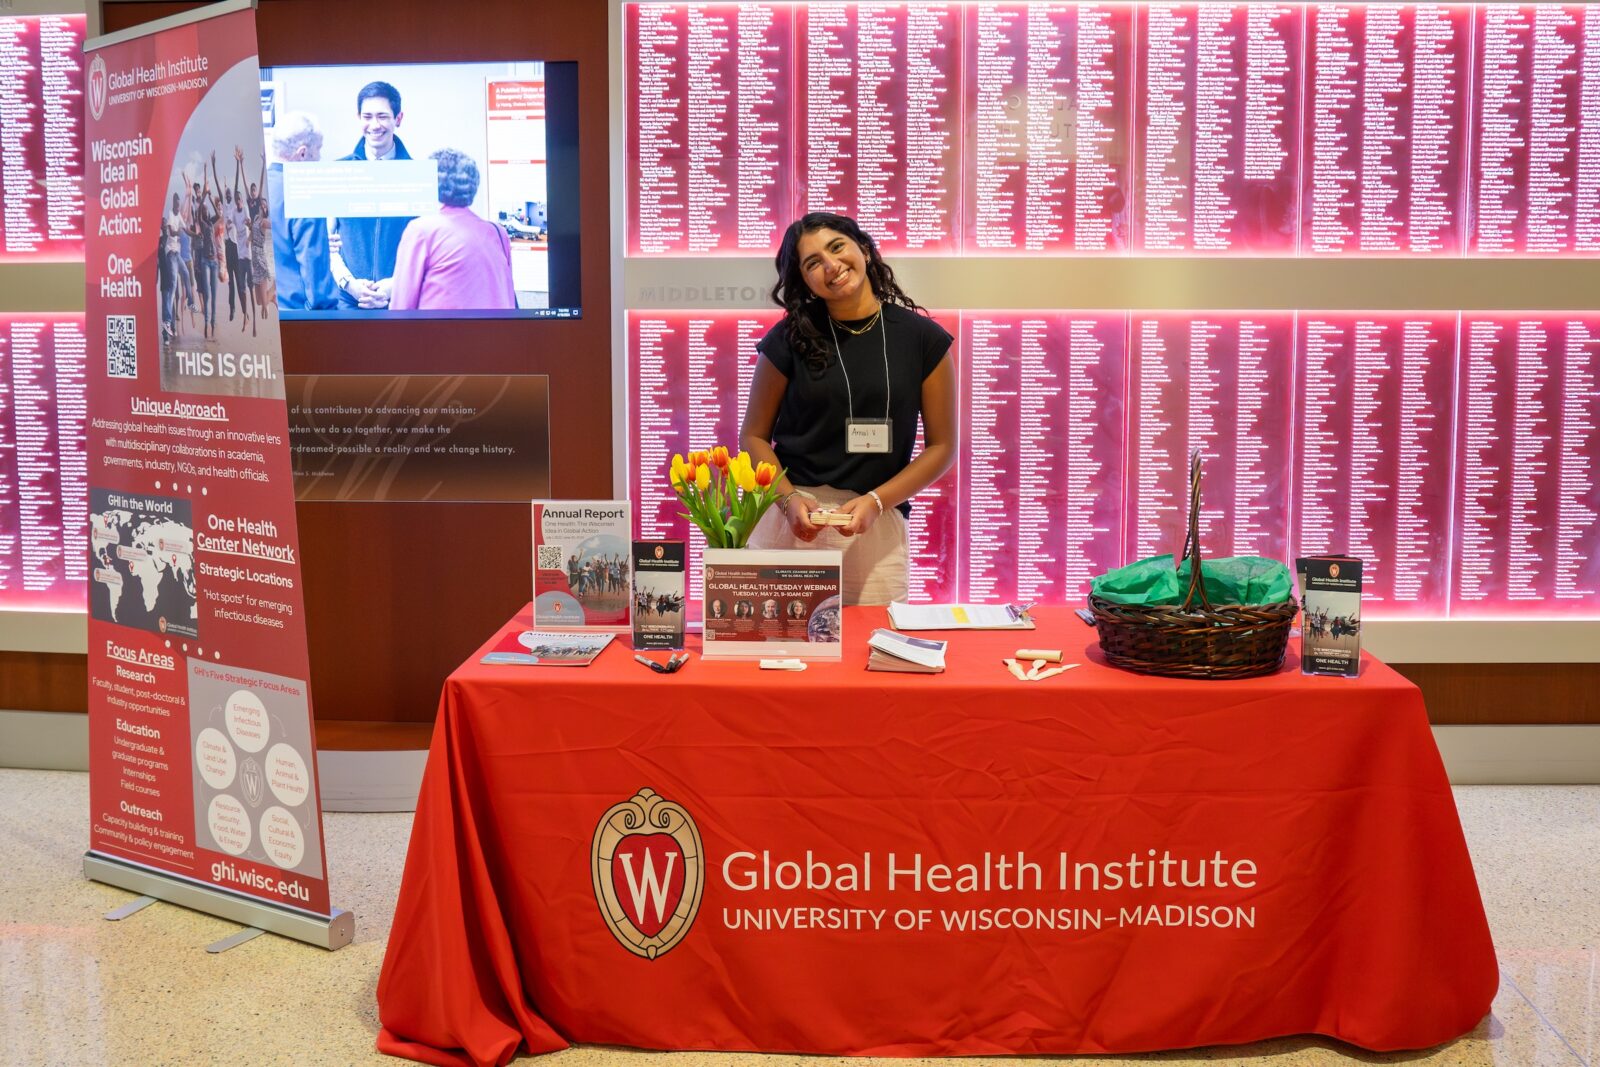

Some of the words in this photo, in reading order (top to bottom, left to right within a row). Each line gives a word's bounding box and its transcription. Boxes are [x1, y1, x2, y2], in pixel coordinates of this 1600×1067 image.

[109, 69, 135, 90] Global
[136, 63, 166, 84] Health
[168, 55, 208, 76] Institute
[109, 91, 136, 106] UNIVERSITY
[137, 89, 145, 100] OF
[92, 133, 152, 162] Wisconsin
[101, 163, 125, 184] Idea
[127, 160, 138, 181] in
[100, 185, 139, 210] Global
[98, 213, 142, 236] Action:
[107, 253, 132, 275] One
[101, 275, 142, 298] Health
[176, 352, 214, 377] THIS
[218, 353, 236, 377] IS
[239, 353, 276, 380] GHI.
[131, 397, 171, 418] Unique
[173, 399, 226, 420] Approach
[291, 405, 300, 415] of
[302, 407, 312, 415] us
[315, 405, 361, 415] contributes
[364, 405, 373, 415] to
[376, 405, 420, 417] advancing
[423, 407, 438, 415] our
[441, 405, 476, 416] mission;
[92, 417, 122, 433] Addressing
[123, 421, 142, 433] global
[144, 421, 167, 434] health
[168, 424, 186, 436] issues
[187, 426, 213, 441] through
[215, 430, 225, 439] an
[227, 429, 265, 443] innovative
[266, 433, 281, 445] lens
[288, 425, 311, 434] when
[328, 425, 340, 434] do
[355, 425, 393, 436] together,
[411, 425, 435, 434] make
[437, 425, 451, 434] the
[105, 437, 117, 447] with
[118, 438, 171, 455] multidisciplinary
[172, 443, 217, 458] collaborations
[218, 448, 226, 458] in
[227, 450, 265, 464] academia,
[383, 444, 411, 455] reality
[414, 444, 431, 453] and
[448, 444, 480, 456] change
[483, 444, 516, 456] history.
[103, 456, 144, 470] governments,
[145, 458, 176, 474] industry,
[177, 461, 197, 476] NGOs,
[198, 466, 211, 477] and
[213, 466, 238, 479] health
[240, 467, 270, 482] officials.
[108, 494, 121, 507] GHI
[122, 496, 129, 508] in
[129, 497, 144, 511] the
[145, 499, 173, 514] World
[543, 508, 582, 519] Annual
[584, 508, 624, 520] Report
[207, 514, 234, 532] One
[237, 517, 278, 538] Health
[197, 532, 240, 553] Center
[241, 539, 295, 562] Network
[200, 562, 244, 582] Strategic
[246, 569, 293, 589] Locations
[246, 595, 257, 607] for
[259, 597, 293, 616] emerging
[214, 607, 251, 623] infectious
[253, 613, 284, 630] diseases
[106, 640, 137, 661] Focus
[138, 648, 175, 669] Areas
[116, 665, 156, 684] Research
[210, 670, 224, 680] Five
[225, 673, 258, 688] Strategic
[259, 680, 279, 691] Focus
[280, 684, 300, 696] Areas
[92, 676, 113, 691] Faculty,
[113, 683, 135, 697] student,
[136, 688, 179, 705] post-doctoral
[180, 696, 186, 706] &
[107, 695, 128, 710] industry
[128, 702, 170, 717] opportunities
[116, 718, 160, 739] Education
[114, 735, 158, 755] Undergraduate
[159, 746, 165, 756] &
[112, 751, 137, 764] graduate
[137, 757, 168, 771] programs
[123, 766, 156, 782] Internships
[120, 779, 135, 791] Field
[135, 785, 160, 797] courses
[120, 800, 162, 821] Outreach
[102, 812, 128, 829] Capacity
[128, 821, 153, 836] building
[153, 827, 159, 836] &
[160, 829, 184, 844] training
[94, 824, 127, 843] Community
[128, 834, 134, 843] &
[134, 836, 153, 849] policy
[153, 842, 194, 859] engagement
[211, 861, 309, 901] ghi.wisc.edu
[722, 850, 870, 892] Global
[888, 851, 1042, 893] Health
[1060, 848, 1257, 891] Institute
[619, 847, 678, 925] W
[722, 907, 886, 930] UNIVERSITY
[894, 909, 931, 930] OF
